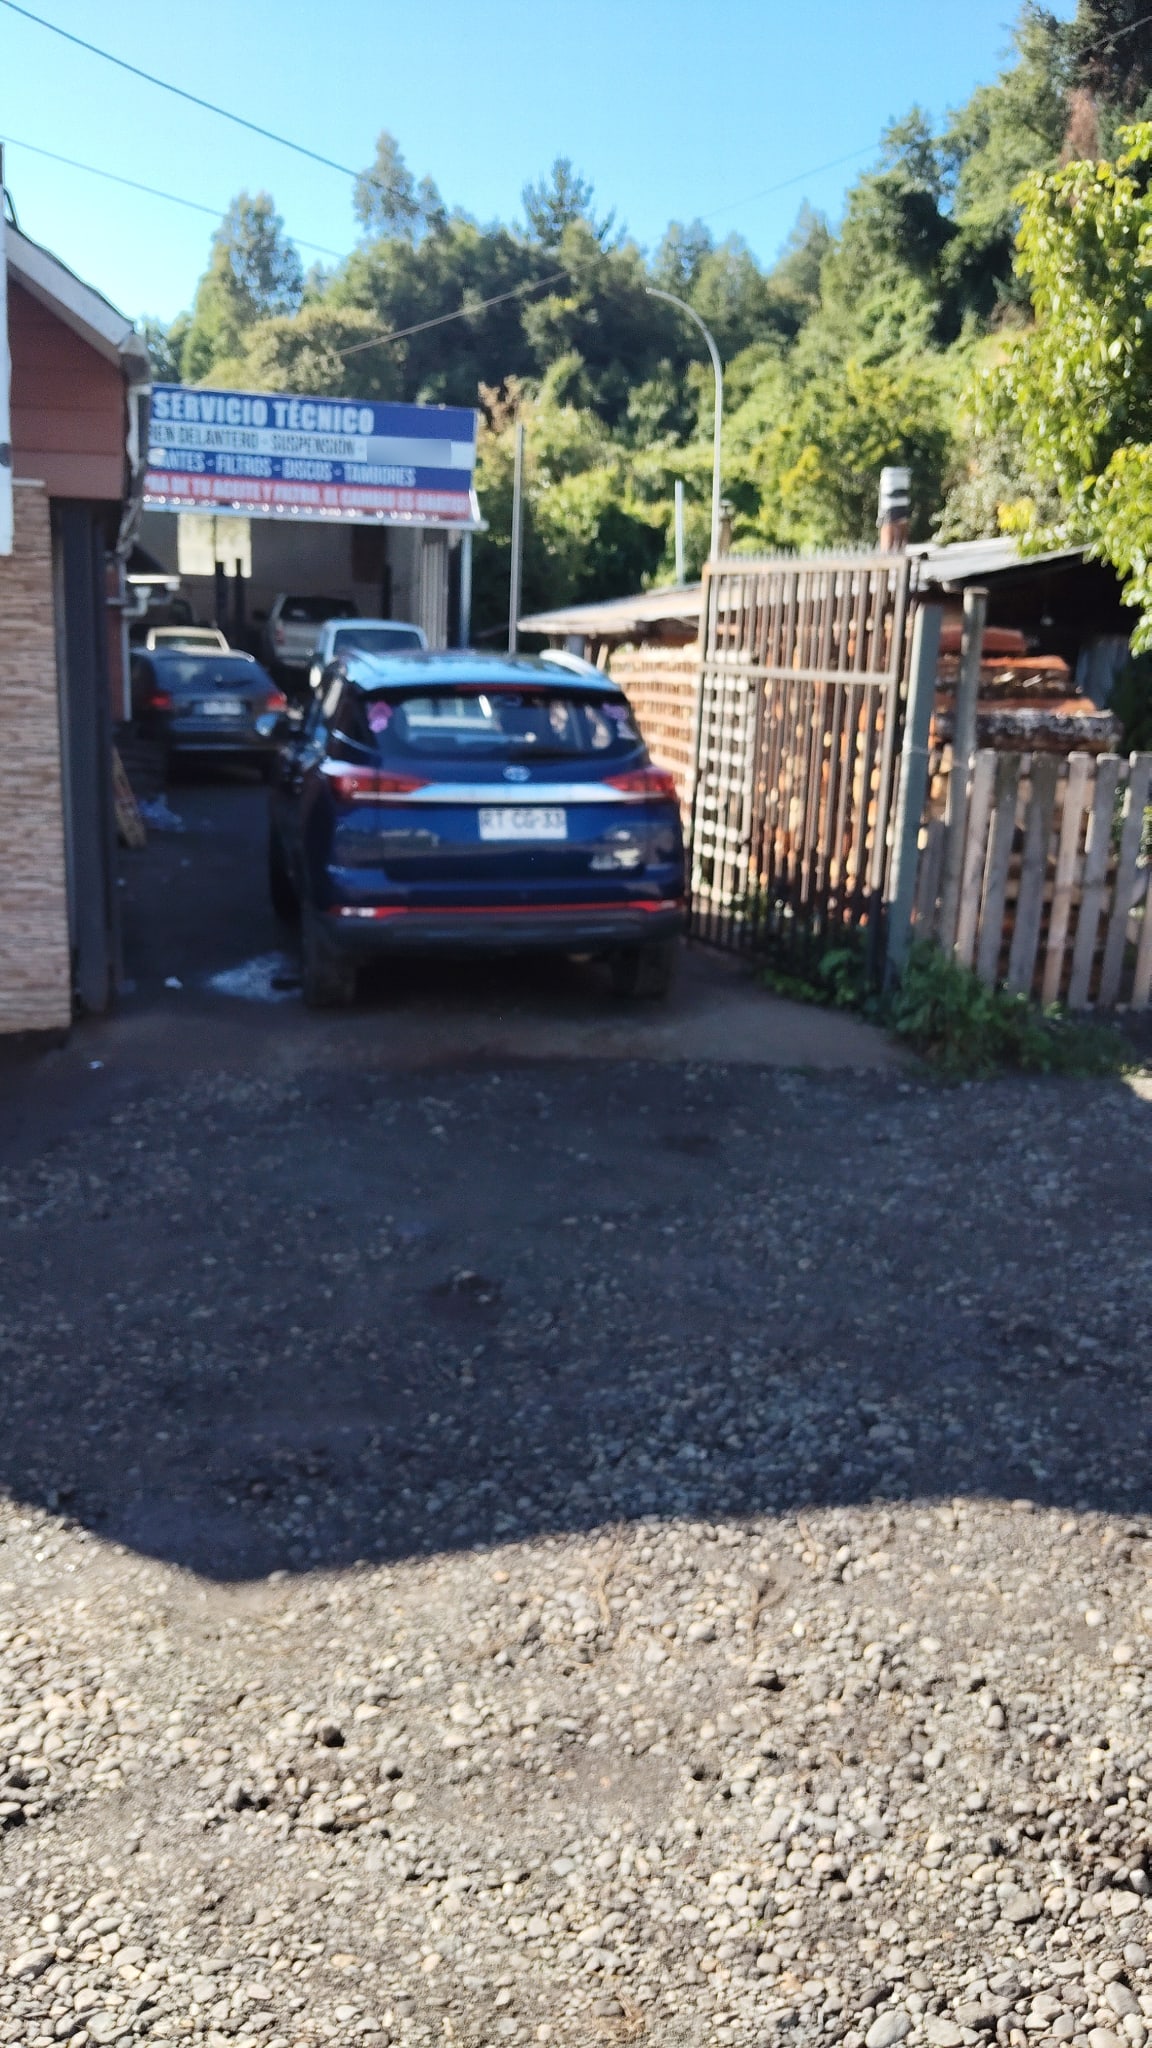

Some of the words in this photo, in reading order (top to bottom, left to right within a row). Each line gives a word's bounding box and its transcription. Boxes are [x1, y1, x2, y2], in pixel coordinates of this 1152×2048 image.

[153, 390, 268, 427] SERVICIO
[272, 398, 375, 435] TÉCNICO
[215, 453, 272, 478] FILTROS
[282, 458, 333, 483] DISCOS
